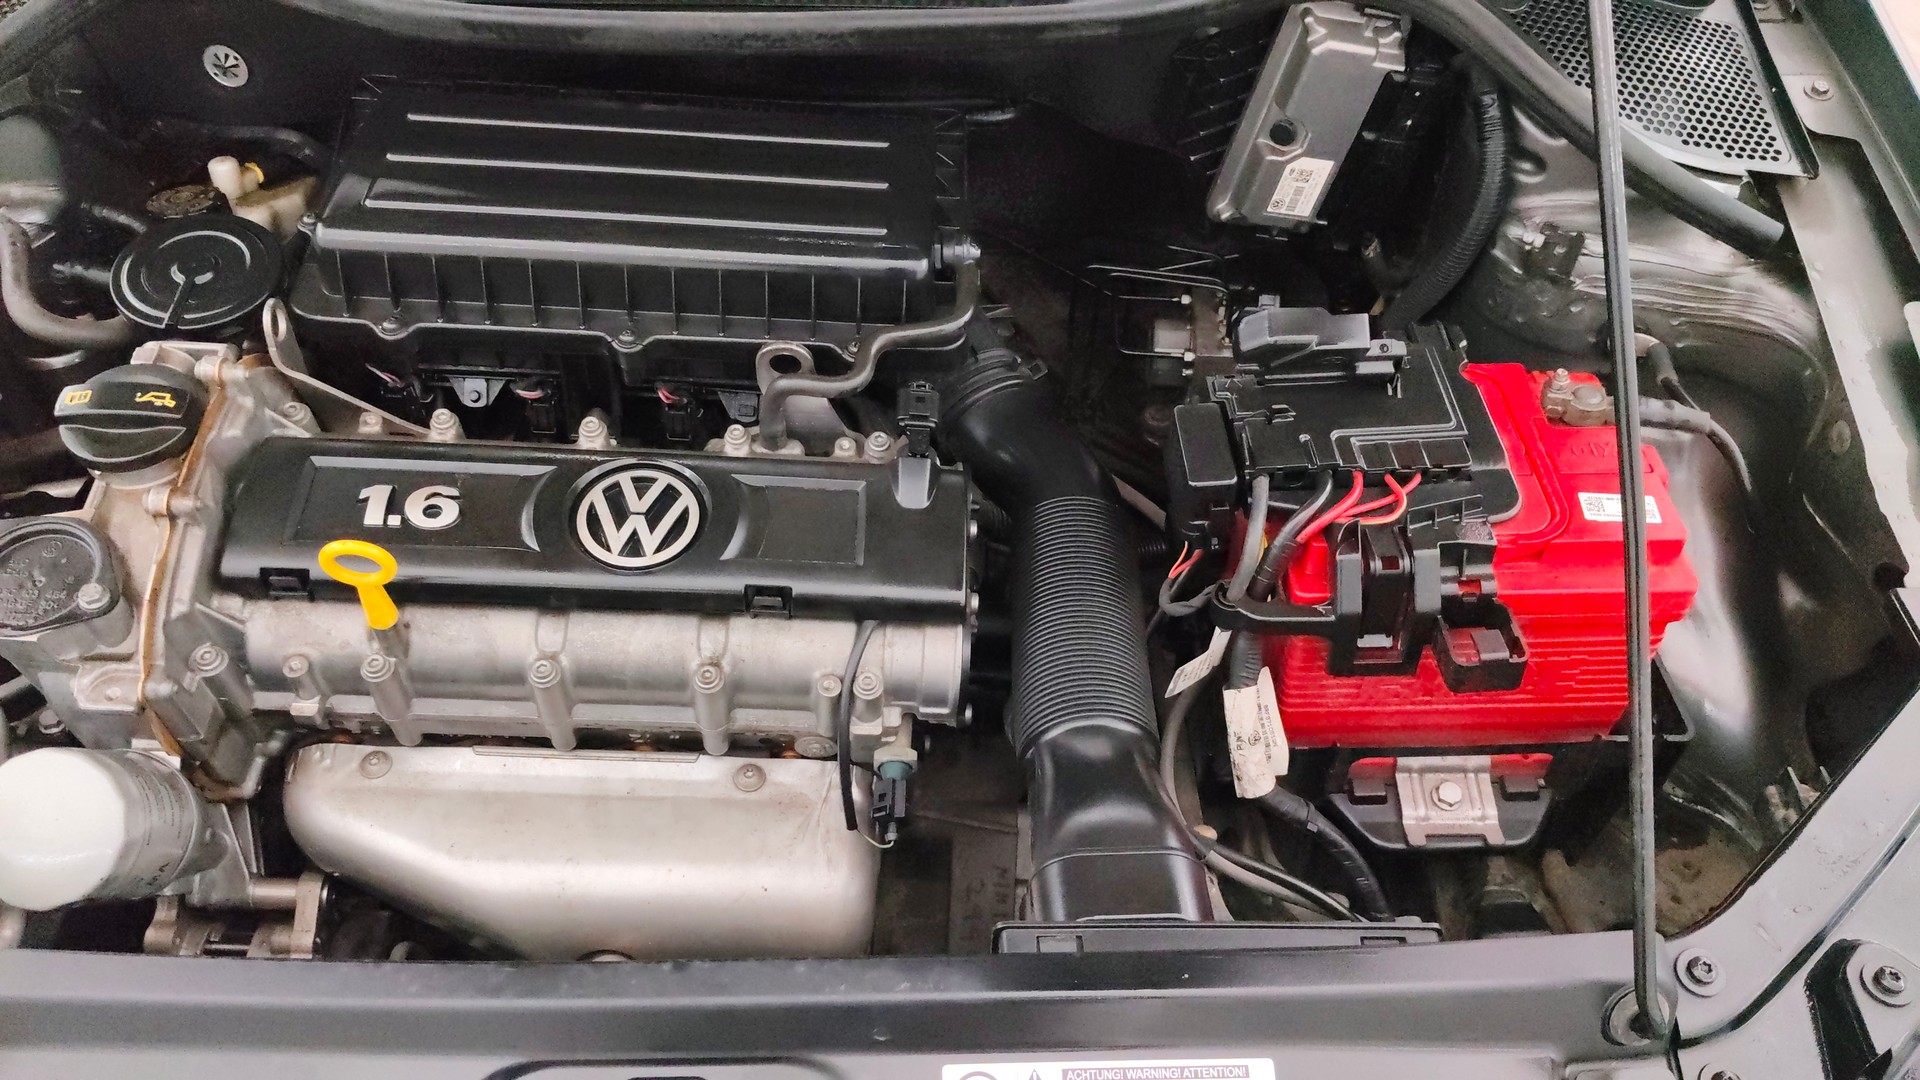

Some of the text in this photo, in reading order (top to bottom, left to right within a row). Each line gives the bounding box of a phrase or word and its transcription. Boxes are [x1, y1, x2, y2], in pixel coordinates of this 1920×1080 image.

[358, 484, 462, 530] 1.6
[576, 469, 700, 568] VW
[1066, 1066, 1246, 1080] ACHTUNG! WARNING! ATTENTION!
